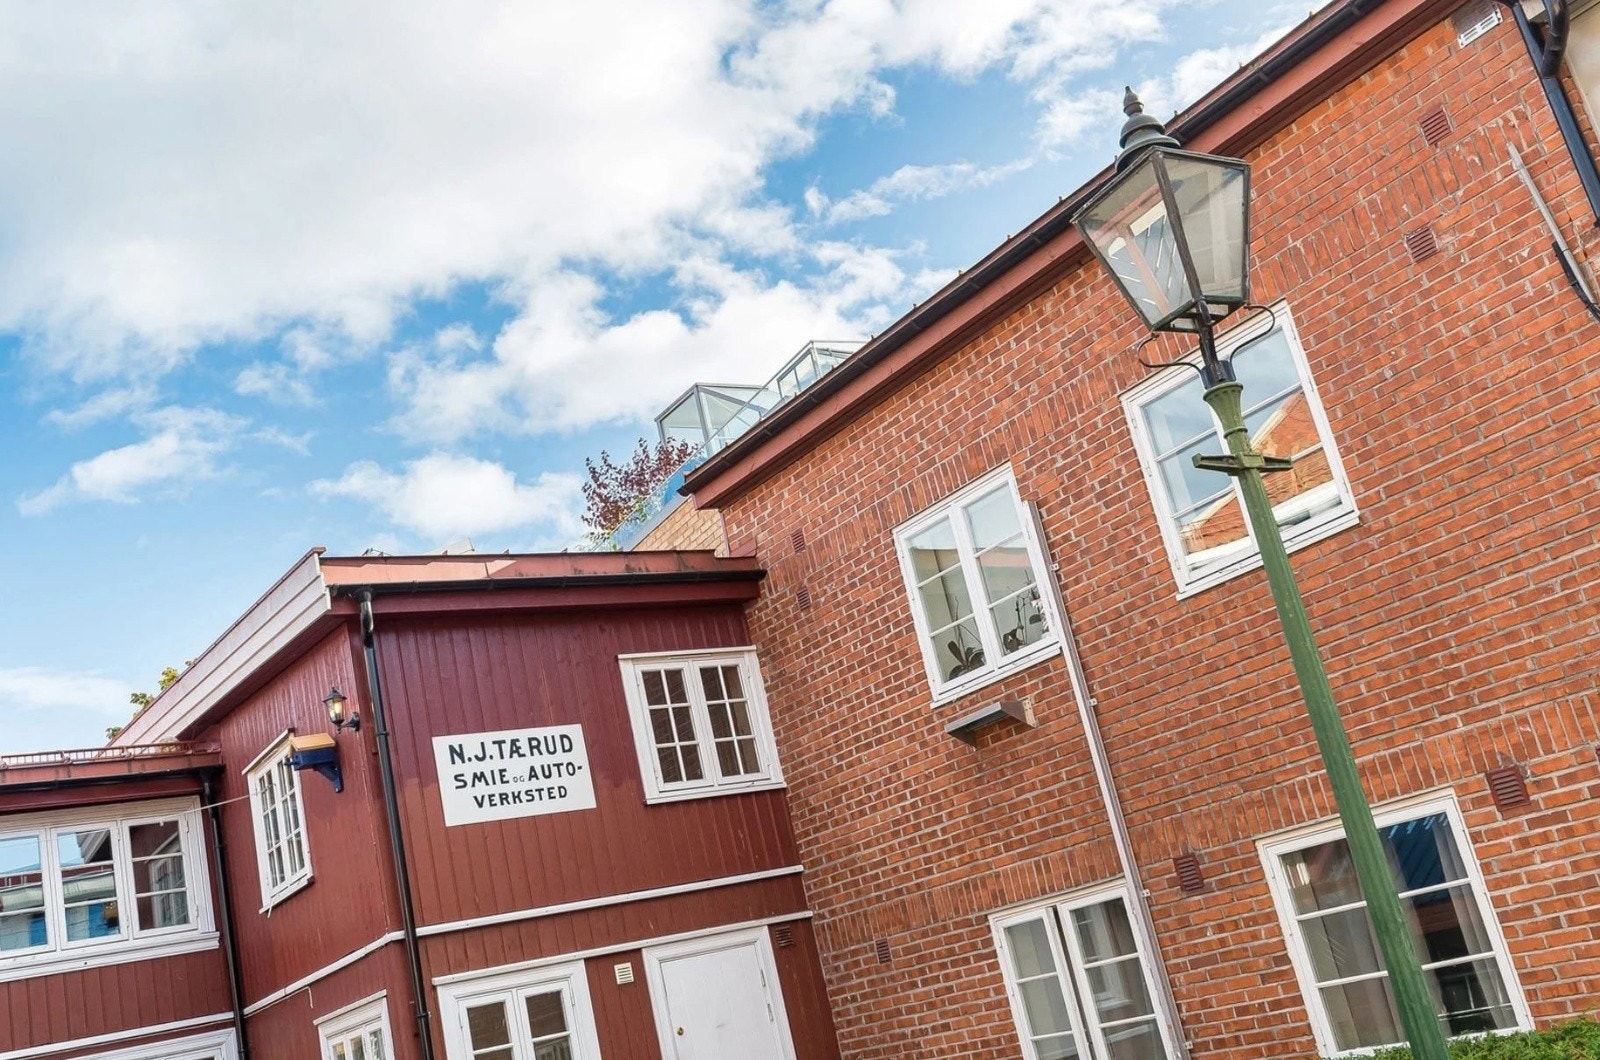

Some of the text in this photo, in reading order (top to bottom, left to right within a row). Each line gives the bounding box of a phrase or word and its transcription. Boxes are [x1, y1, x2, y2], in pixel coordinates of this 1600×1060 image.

[453, 768, 510, 790] SMIE
[528, 761, 584, 782] AUTO-
[473, 785, 569, 809] VERKSTED
